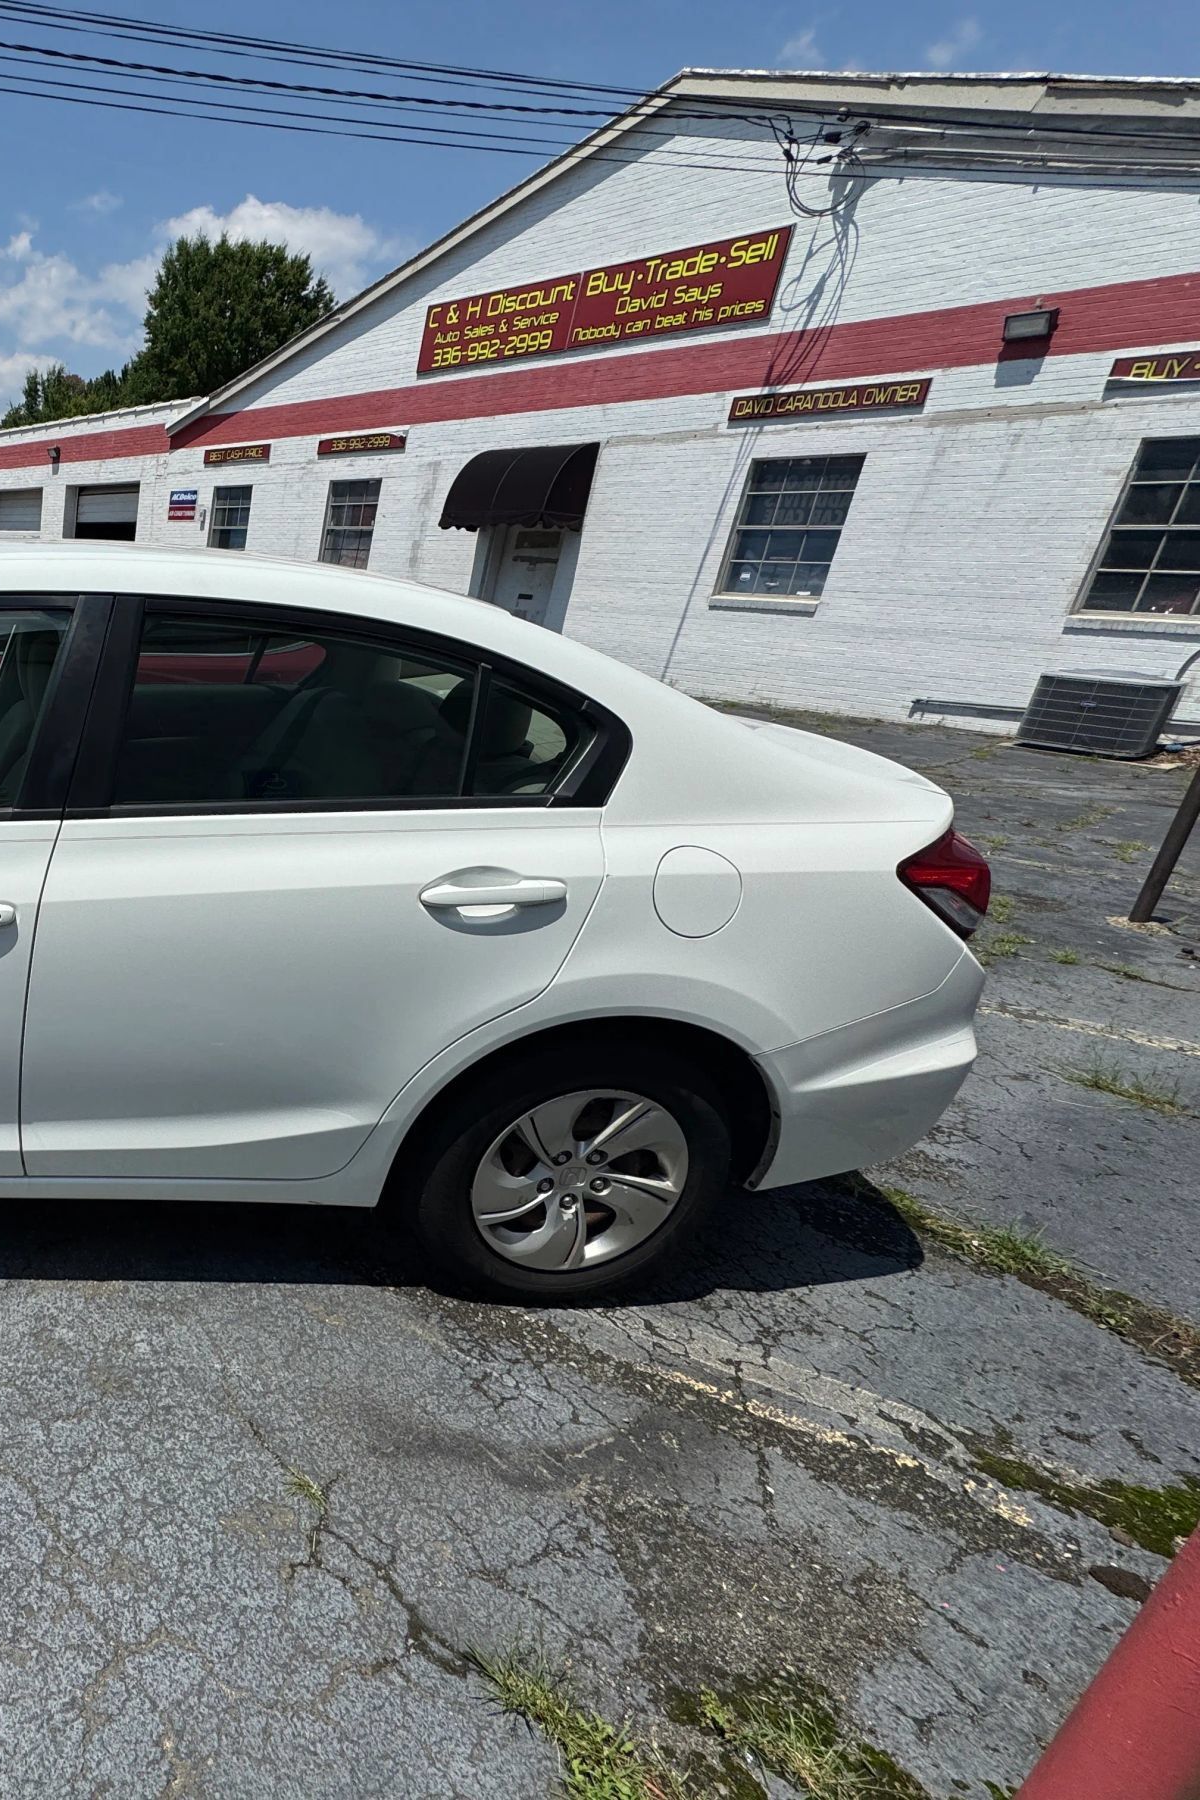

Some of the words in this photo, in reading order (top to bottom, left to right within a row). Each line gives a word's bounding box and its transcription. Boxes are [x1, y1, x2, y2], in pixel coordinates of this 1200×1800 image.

[428, 307, 442, 328] C
[446, 303, 460, 325] &
[466, 298, 483, 321] H
[486, 280, 576, 317] Discount
[614, 289, 669, 315] David
[672, 282, 723, 305] Says
[434, 330, 460, 345] Auto
[463, 323, 495, 340] Sales
[499, 319, 509, 333] &
[512, 311, 560, 331] Service
[625, 318, 650, 334] can
[654, 311, 688, 330] beat
[691, 305, 714, 323] his
[717, 298, 765, 322] prices
[431, 329, 553, 368] 336-992-2999
[735, 399, 773, 416] DAVID
[776, 389, 858, 413] CARANDOLA
[862, 383, 921, 405] OWNER
[209, 451, 225, 462] BEST
[226, 449, 244, 460] CASH
[244, 446, 264, 458] PRICE
[331, 435, 391, 451] 336-992-2999
[171, 491, 197, 501] ACDelco
